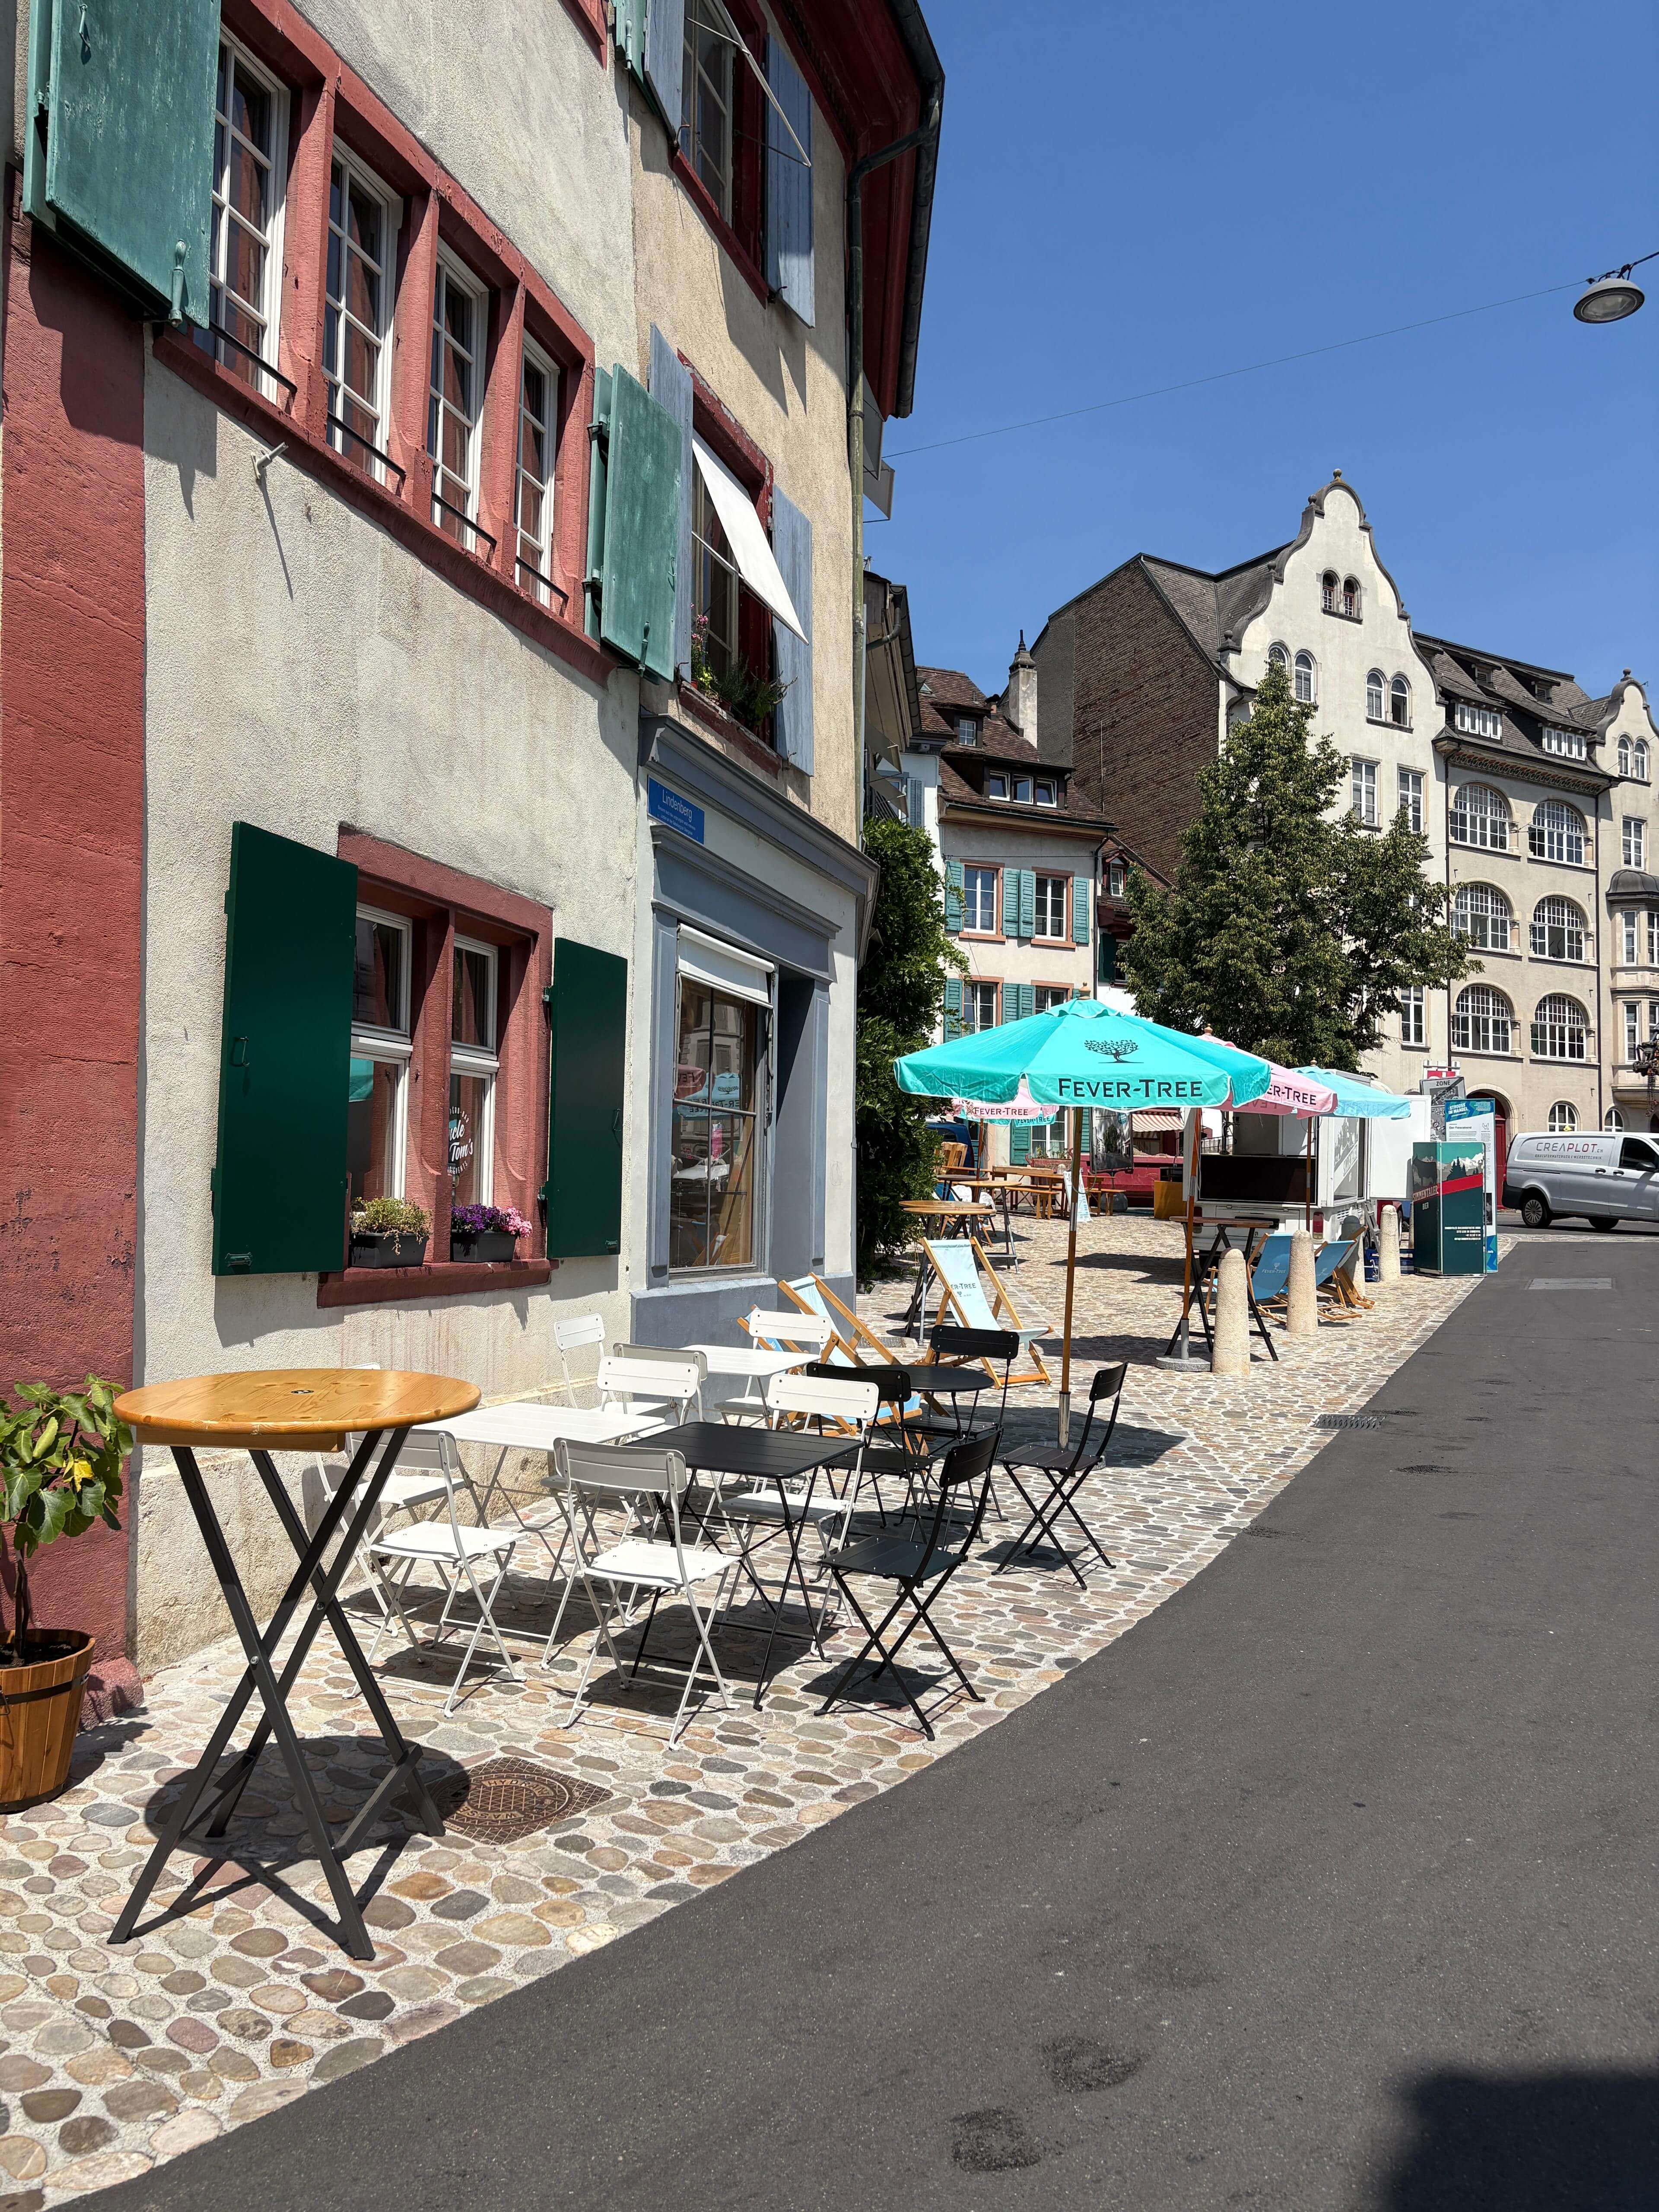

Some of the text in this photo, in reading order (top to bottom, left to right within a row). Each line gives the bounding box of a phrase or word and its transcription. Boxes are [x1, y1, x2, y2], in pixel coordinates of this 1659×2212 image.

[662, 789, 692, 822] Lindenberg
[1058, 1078, 1202, 1098] FEVER-TREE
[1267, 1084, 1316, 1105] ER-TREE
[974, 1107, 1028, 1116] FEVER-TREE
[449, 1138, 473, 1161] Tom's
[458, 1806, 516, 1819] WASSE
